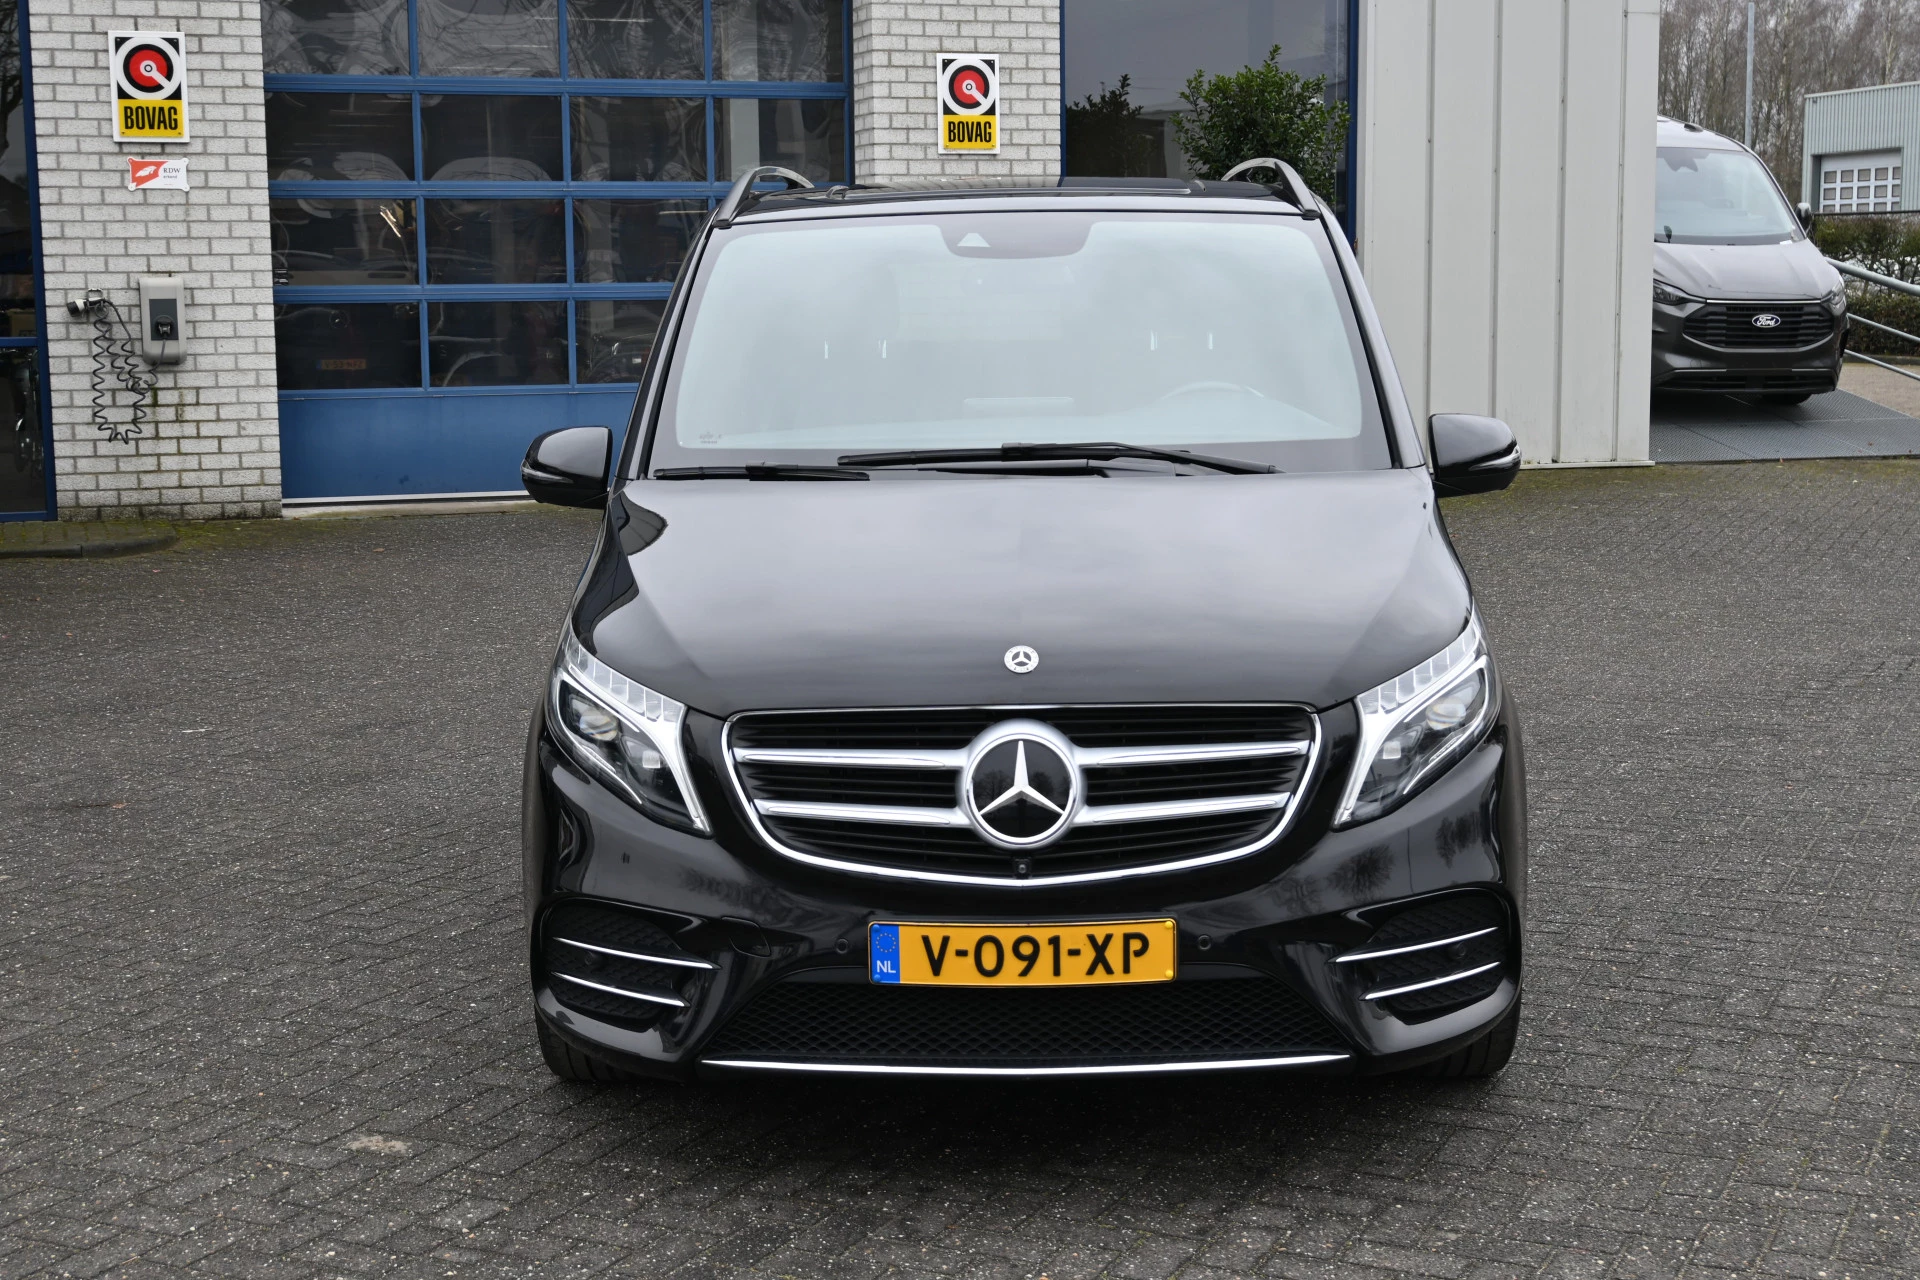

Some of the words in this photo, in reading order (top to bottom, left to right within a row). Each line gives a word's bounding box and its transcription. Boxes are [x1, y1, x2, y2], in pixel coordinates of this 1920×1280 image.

[124, 105, 178, 131] BOVAG
[947, 121, 992, 143] BOVAG
[1756, 316, 1776, 326] Ford
[921, 932, 1150, 978] V-091-XP
[876, 960, 896, 974] NL
